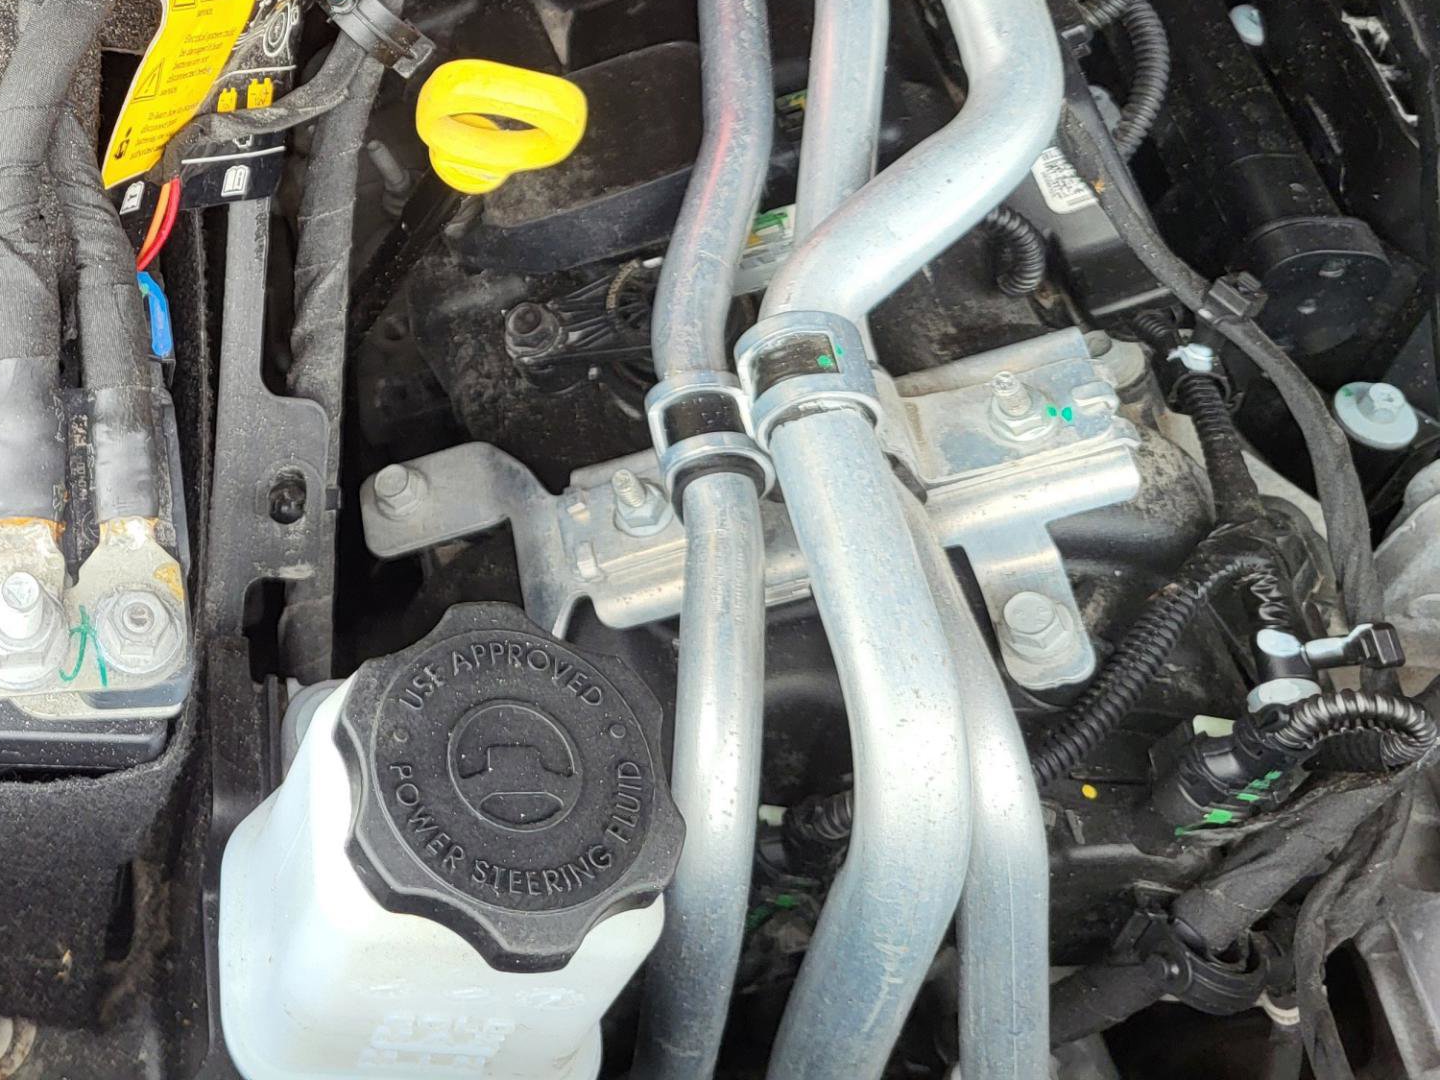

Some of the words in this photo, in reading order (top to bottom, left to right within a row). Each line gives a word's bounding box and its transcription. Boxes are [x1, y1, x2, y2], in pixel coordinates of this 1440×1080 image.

[397, 664, 447, 711] USE
[450, 640, 605, 708] APPROVED
[389, 763, 467, 870] POWER
[470, 844, 613, 897] STEERING
[606, 760, 643, 845] FLUID
